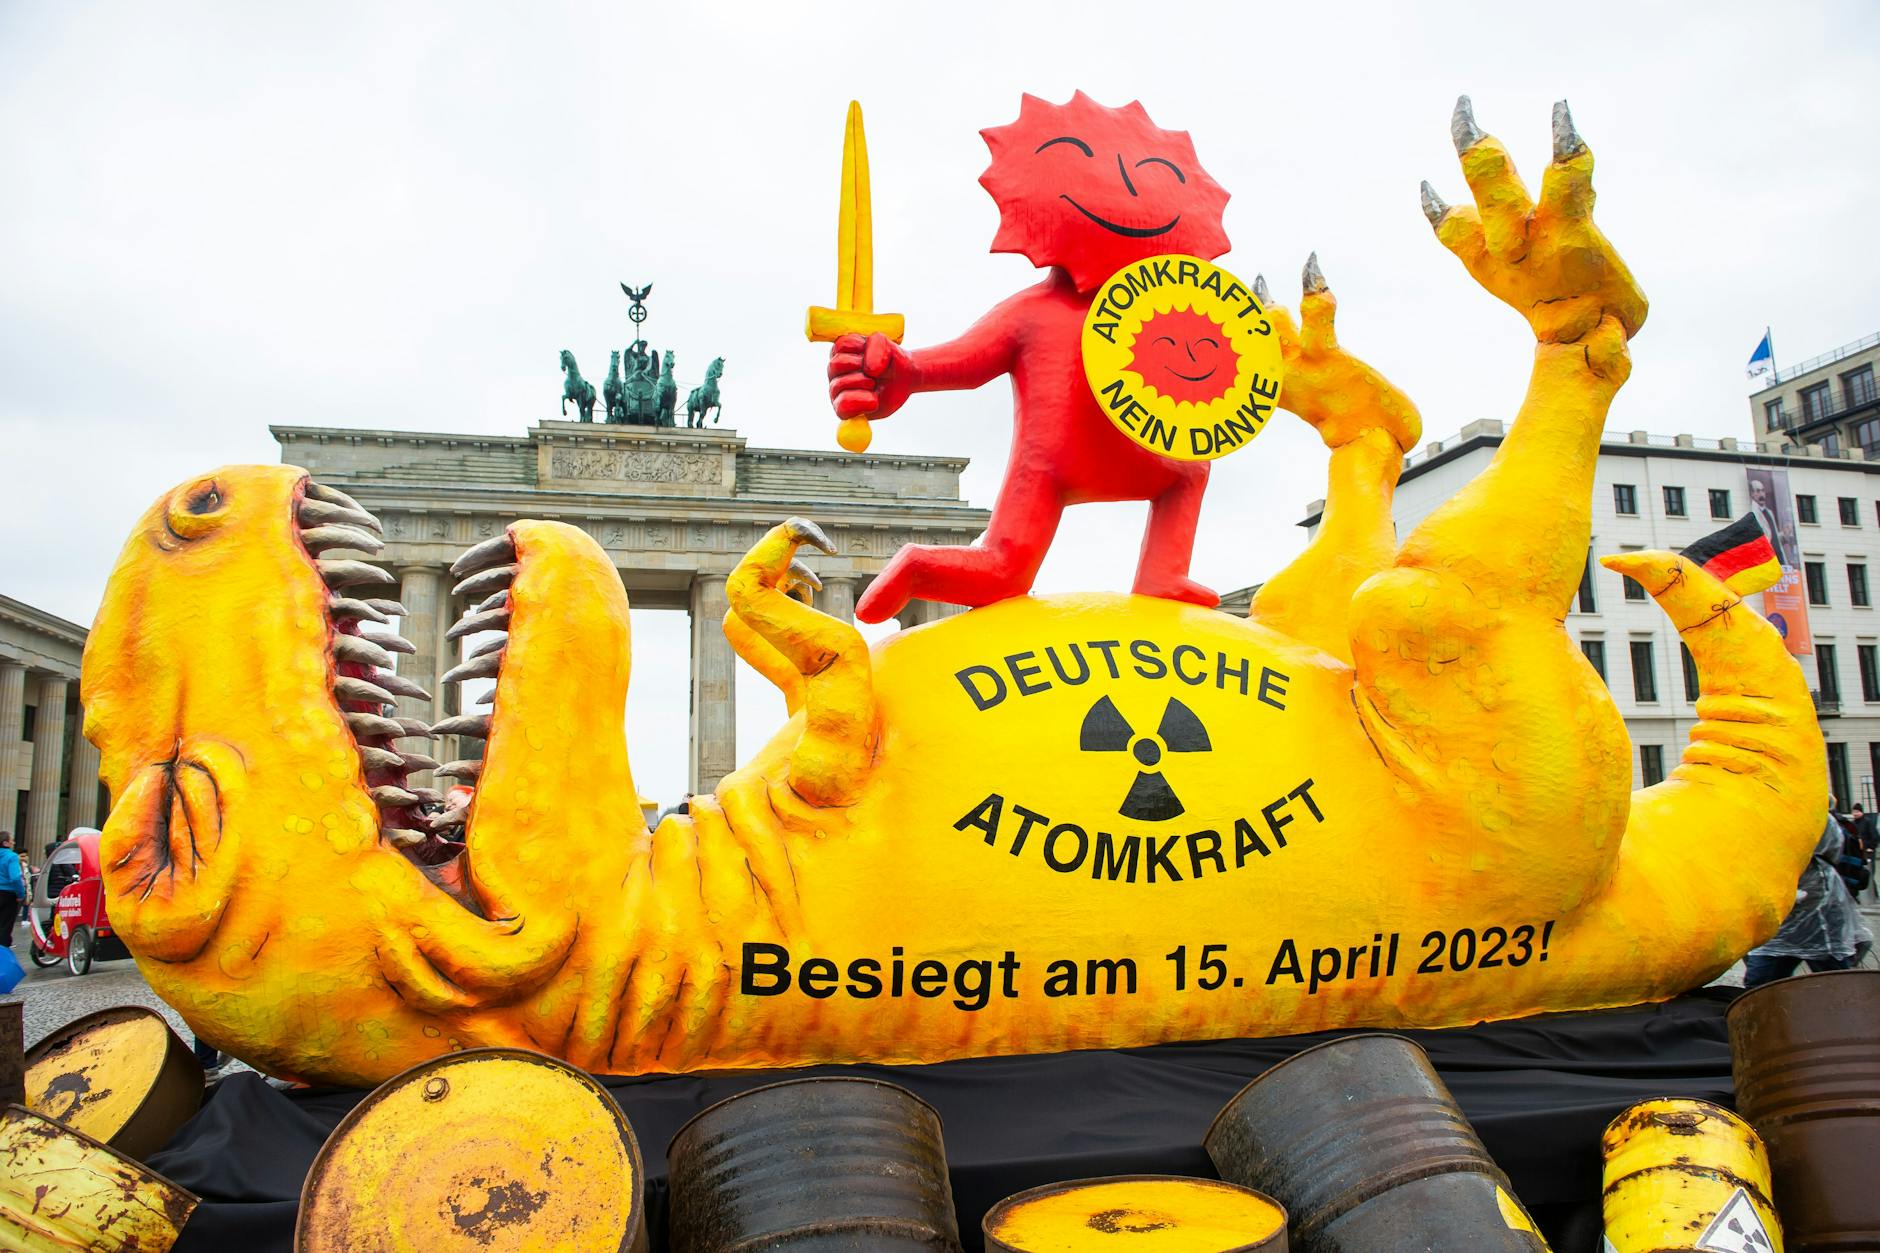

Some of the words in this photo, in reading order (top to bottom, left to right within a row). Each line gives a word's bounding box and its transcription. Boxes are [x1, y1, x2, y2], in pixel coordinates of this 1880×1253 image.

[1093, 259, 1272, 344] ATOMKRAFT?
[1101, 379, 1177, 452] NEIN
[1190, 373, 1279, 456] DANKE
[955, 639, 1291, 712] DEUTSCHE
[953, 778, 1325, 884] ATOMKRAFT
[740, 942, 1021, 1012] Besiegt
[1043, 958, 1137, 997] am
[1165, 944, 1244, 991] 15.
[1265, 933, 1400, 995] April
[1417, 920, 1555, 974] 2023!
